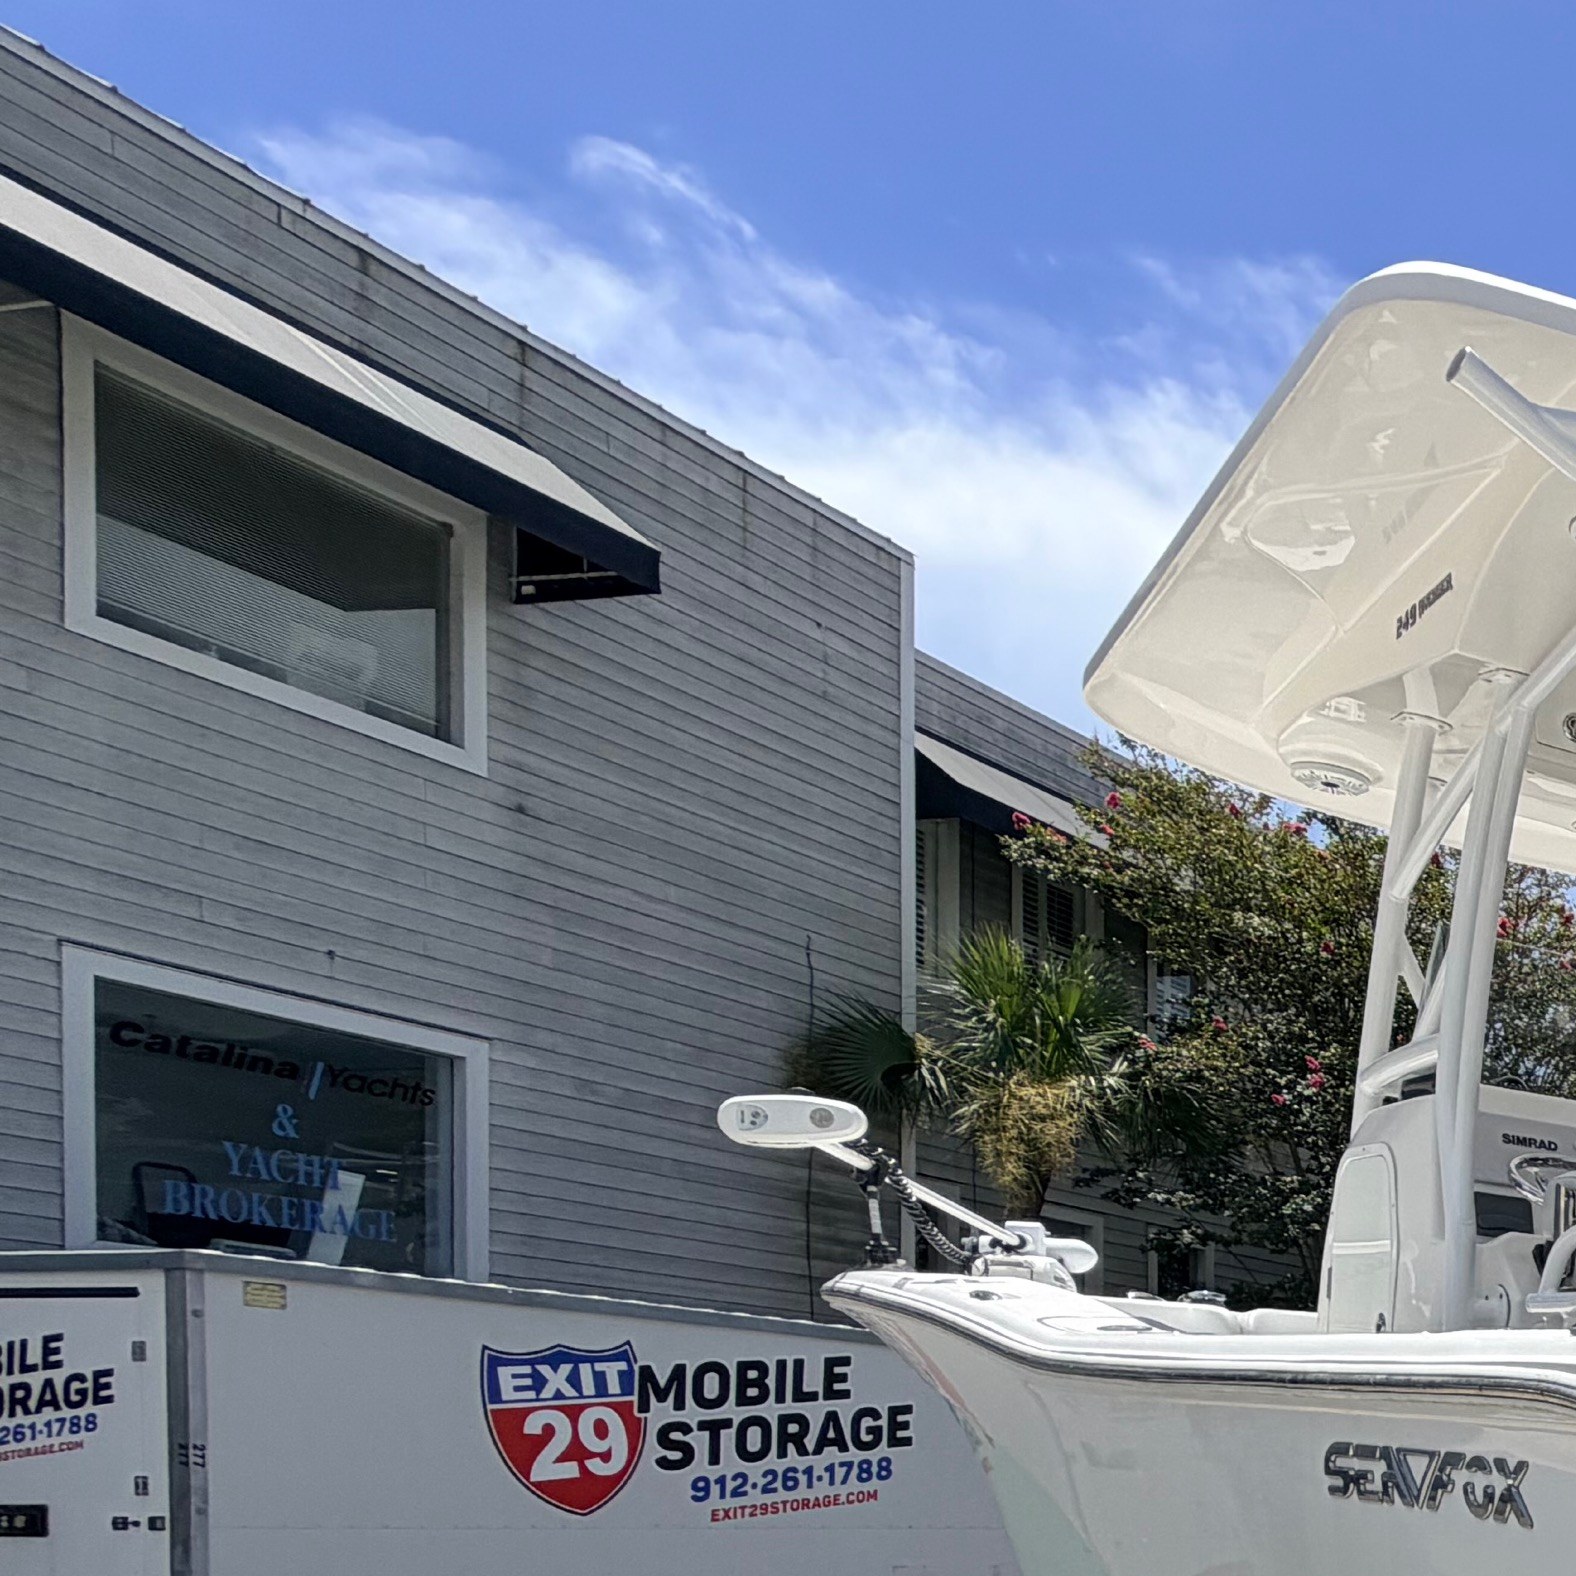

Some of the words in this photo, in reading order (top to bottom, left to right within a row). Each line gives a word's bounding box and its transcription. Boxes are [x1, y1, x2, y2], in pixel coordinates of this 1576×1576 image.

[109, 1020, 299, 1080] Catalina
[328, 1063, 435, 1106] Yachts
[272, 1103, 299, 1138] &
[1502, 1132, 1558, 1151] SIMRAD
[222, 1141, 346, 1191] YACHT
[161, 1179, 396, 1242] BROKERAGE
[0, 1332, 64, 1377] ILE
[0, 1368, 115, 1419] RAGE
[497, 1361, 628, 1401] EXIT
[637, 1356, 852, 1414] MOBILE
[192, 1443, 206, 1468] 277
[522, 1406, 629, 1483] 29
[653, 1405, 914, 1471] STORAGE
[709, 1490, 878, 1522] EXIT29STORAGE.COM
